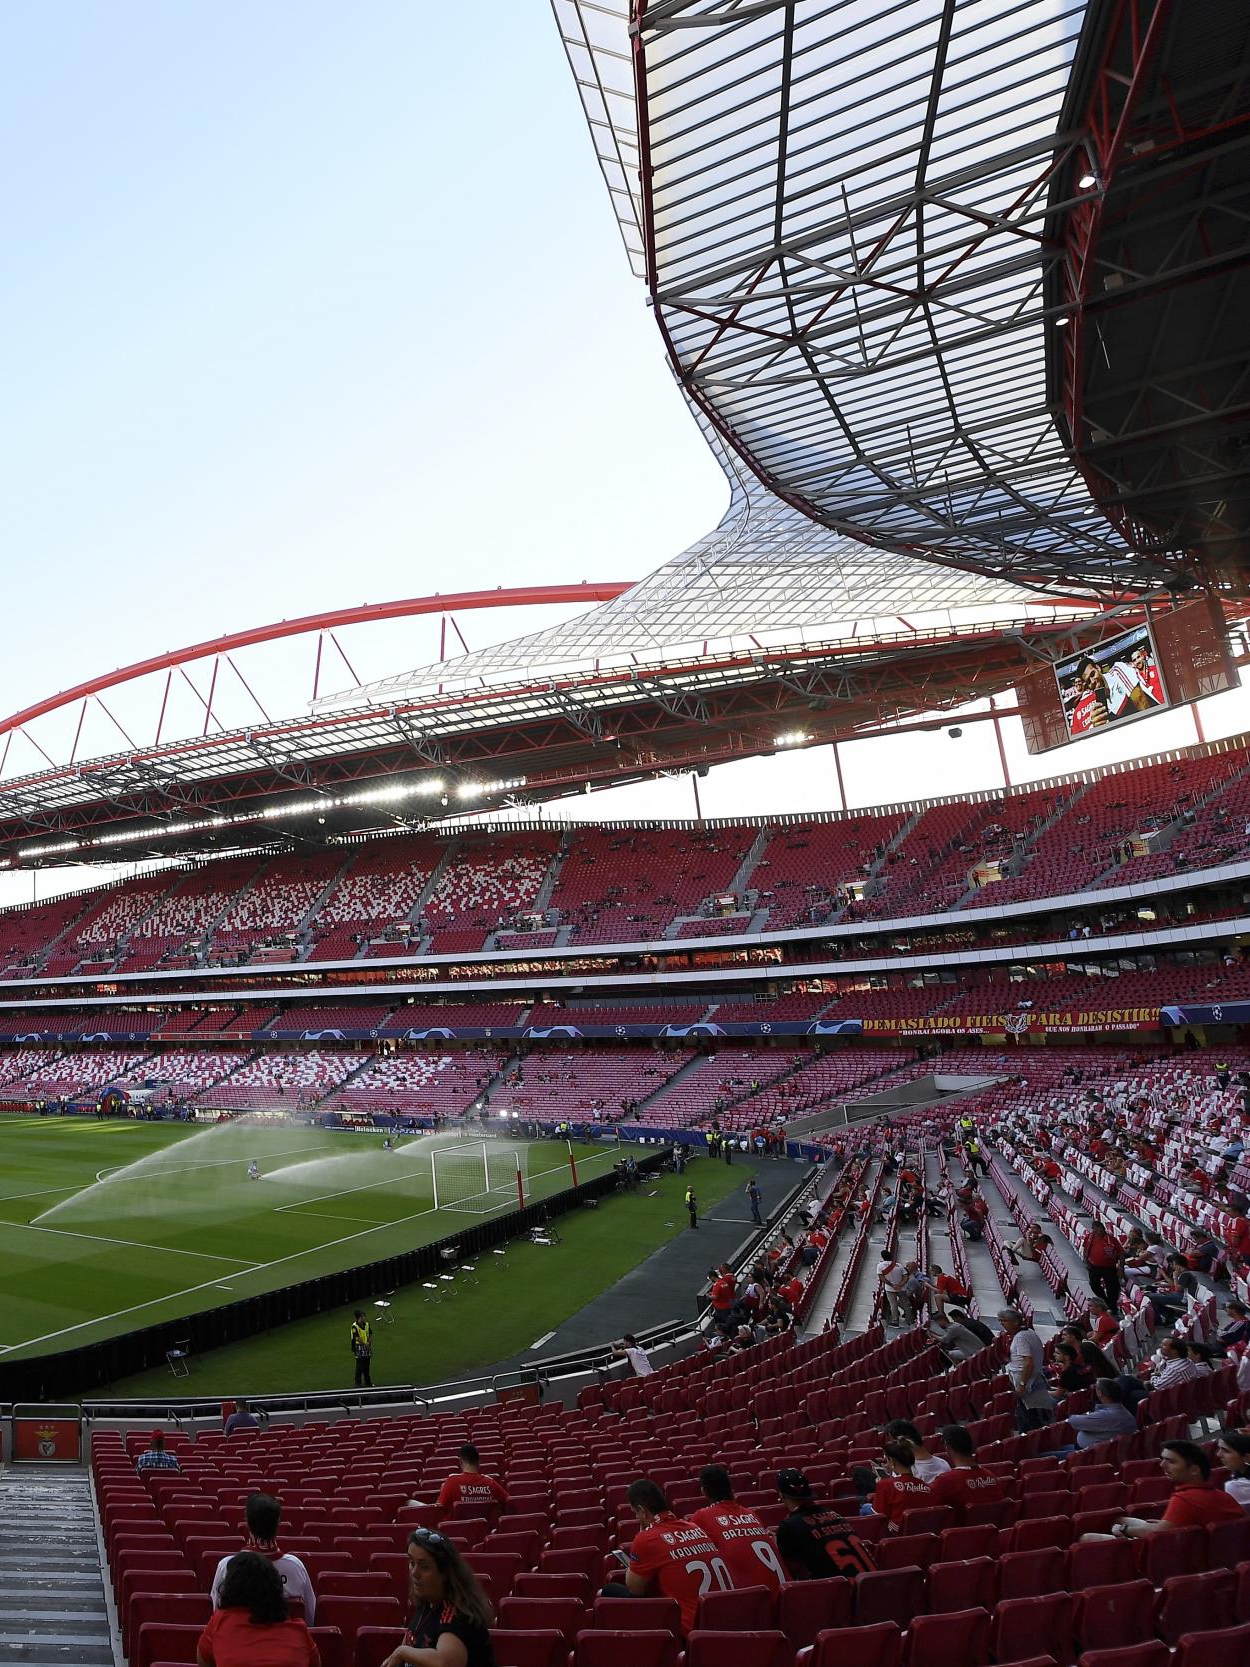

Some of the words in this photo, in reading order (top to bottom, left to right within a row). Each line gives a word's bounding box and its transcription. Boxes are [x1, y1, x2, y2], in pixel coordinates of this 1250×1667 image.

[863, 1017, 961, 1030] DEMASIADO
[966, 1015, 1007, 1027] FIEIS
[1026, 1013, 1072, 1025] PARA
[1078, 1008, 1160, 1025] DESISTIR!!
[356, 1125, 384, 1133] Heineken
[467, 1485, 491, 1495] SAGRES
[751, 1541, 786, 1584] 9
[685, 1557, 734, 1594] 20
